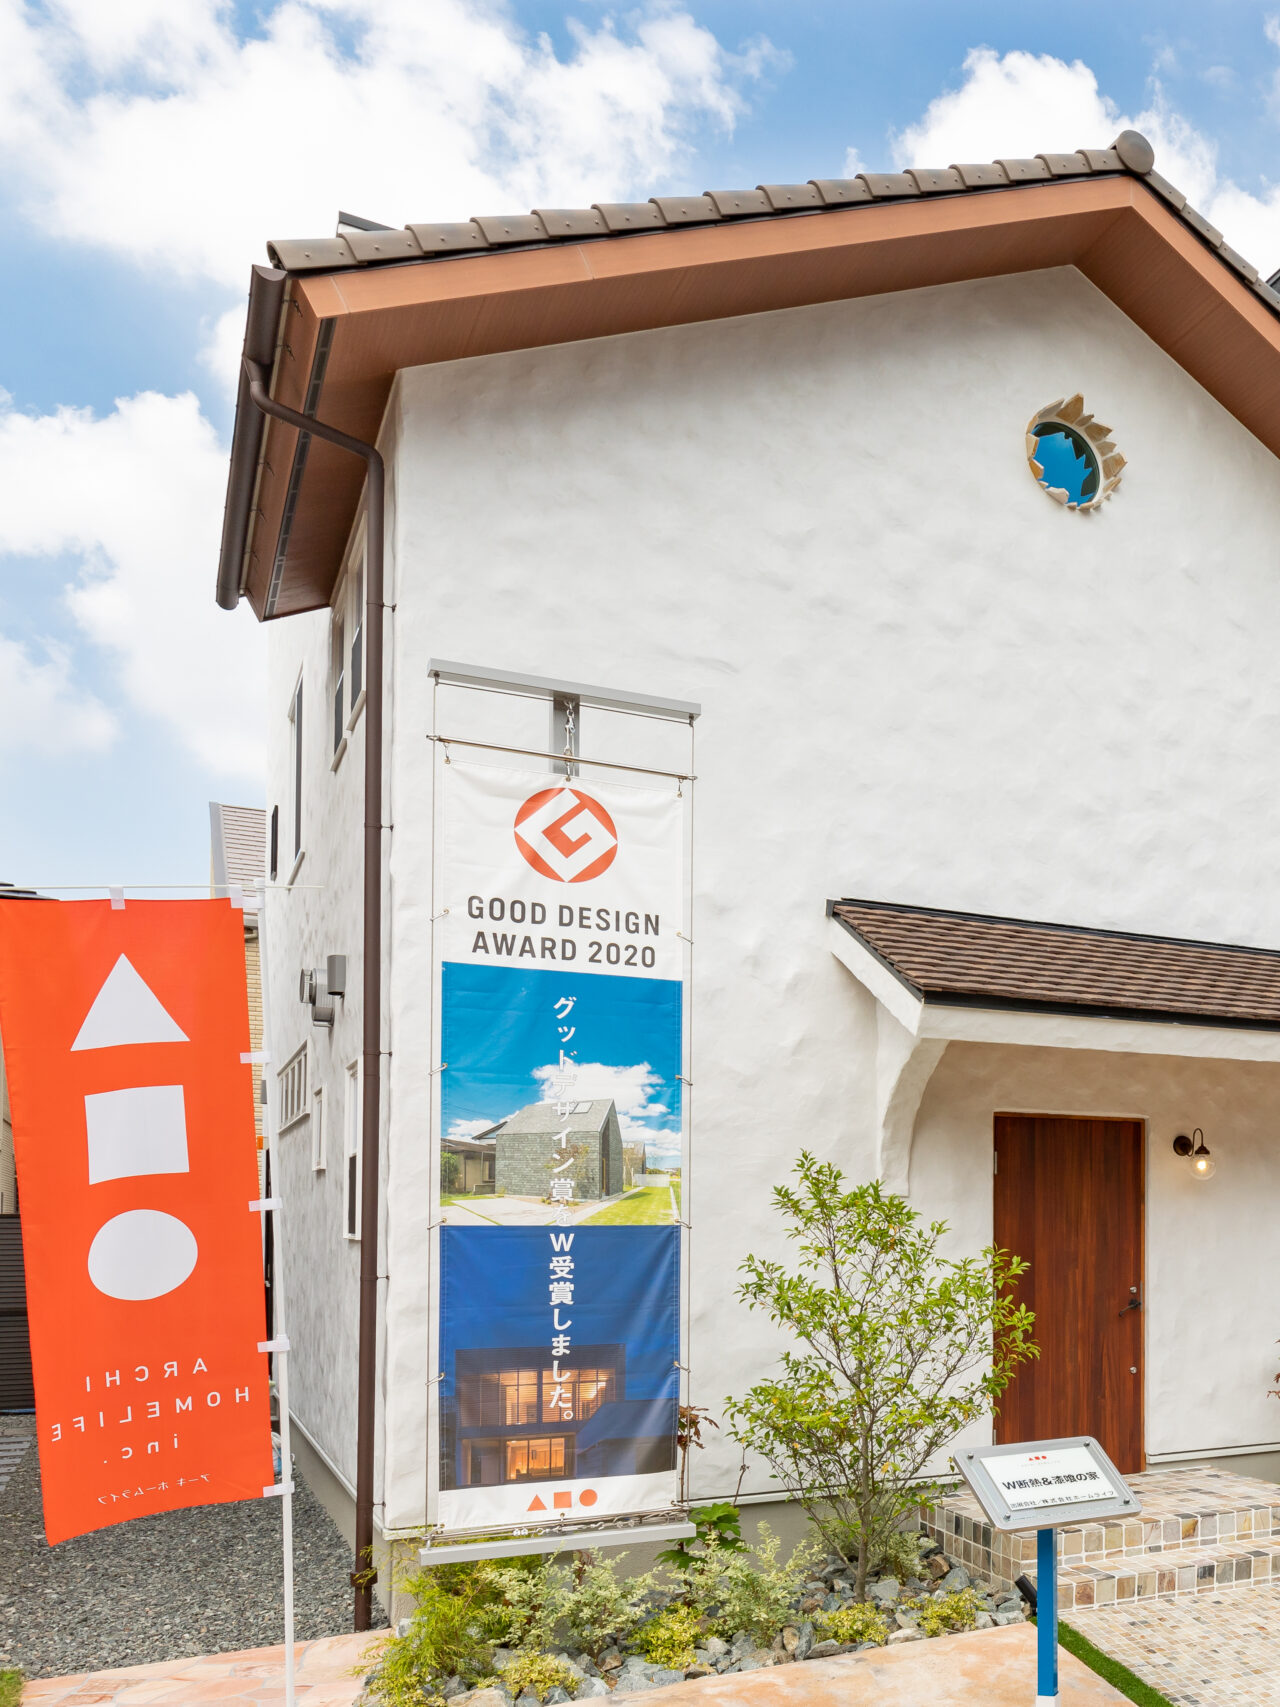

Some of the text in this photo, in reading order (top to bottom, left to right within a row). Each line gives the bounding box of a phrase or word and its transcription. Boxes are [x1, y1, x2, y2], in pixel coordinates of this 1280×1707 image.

[467, 895, 660, 936] GOOD DESIGN
[471, 931, 657, 969] AWARD 2020
[1001, 1470, 1101, 1491] W断熱&漆喰の家
